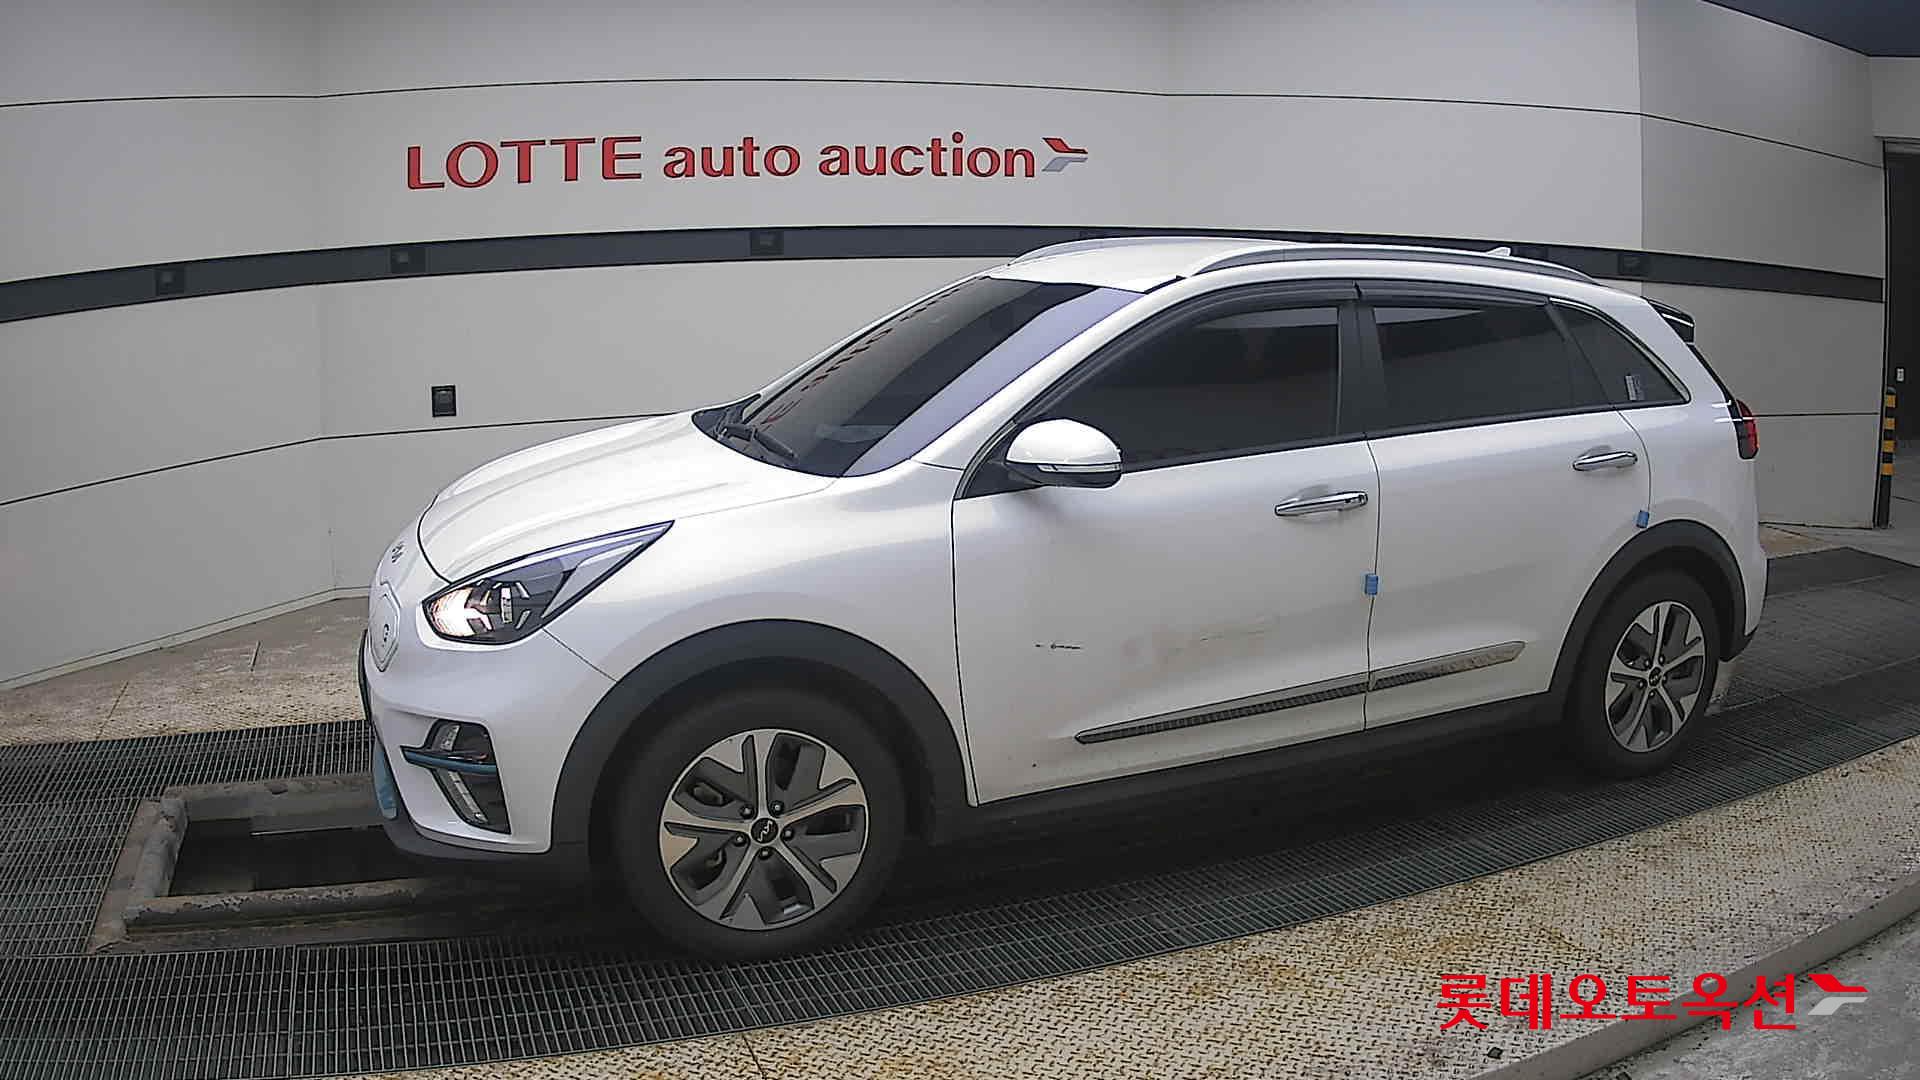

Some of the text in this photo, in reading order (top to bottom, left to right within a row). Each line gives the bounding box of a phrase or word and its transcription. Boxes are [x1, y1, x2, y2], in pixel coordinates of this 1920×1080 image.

[407, 131, 1036, 190] LOTTE auto auction
